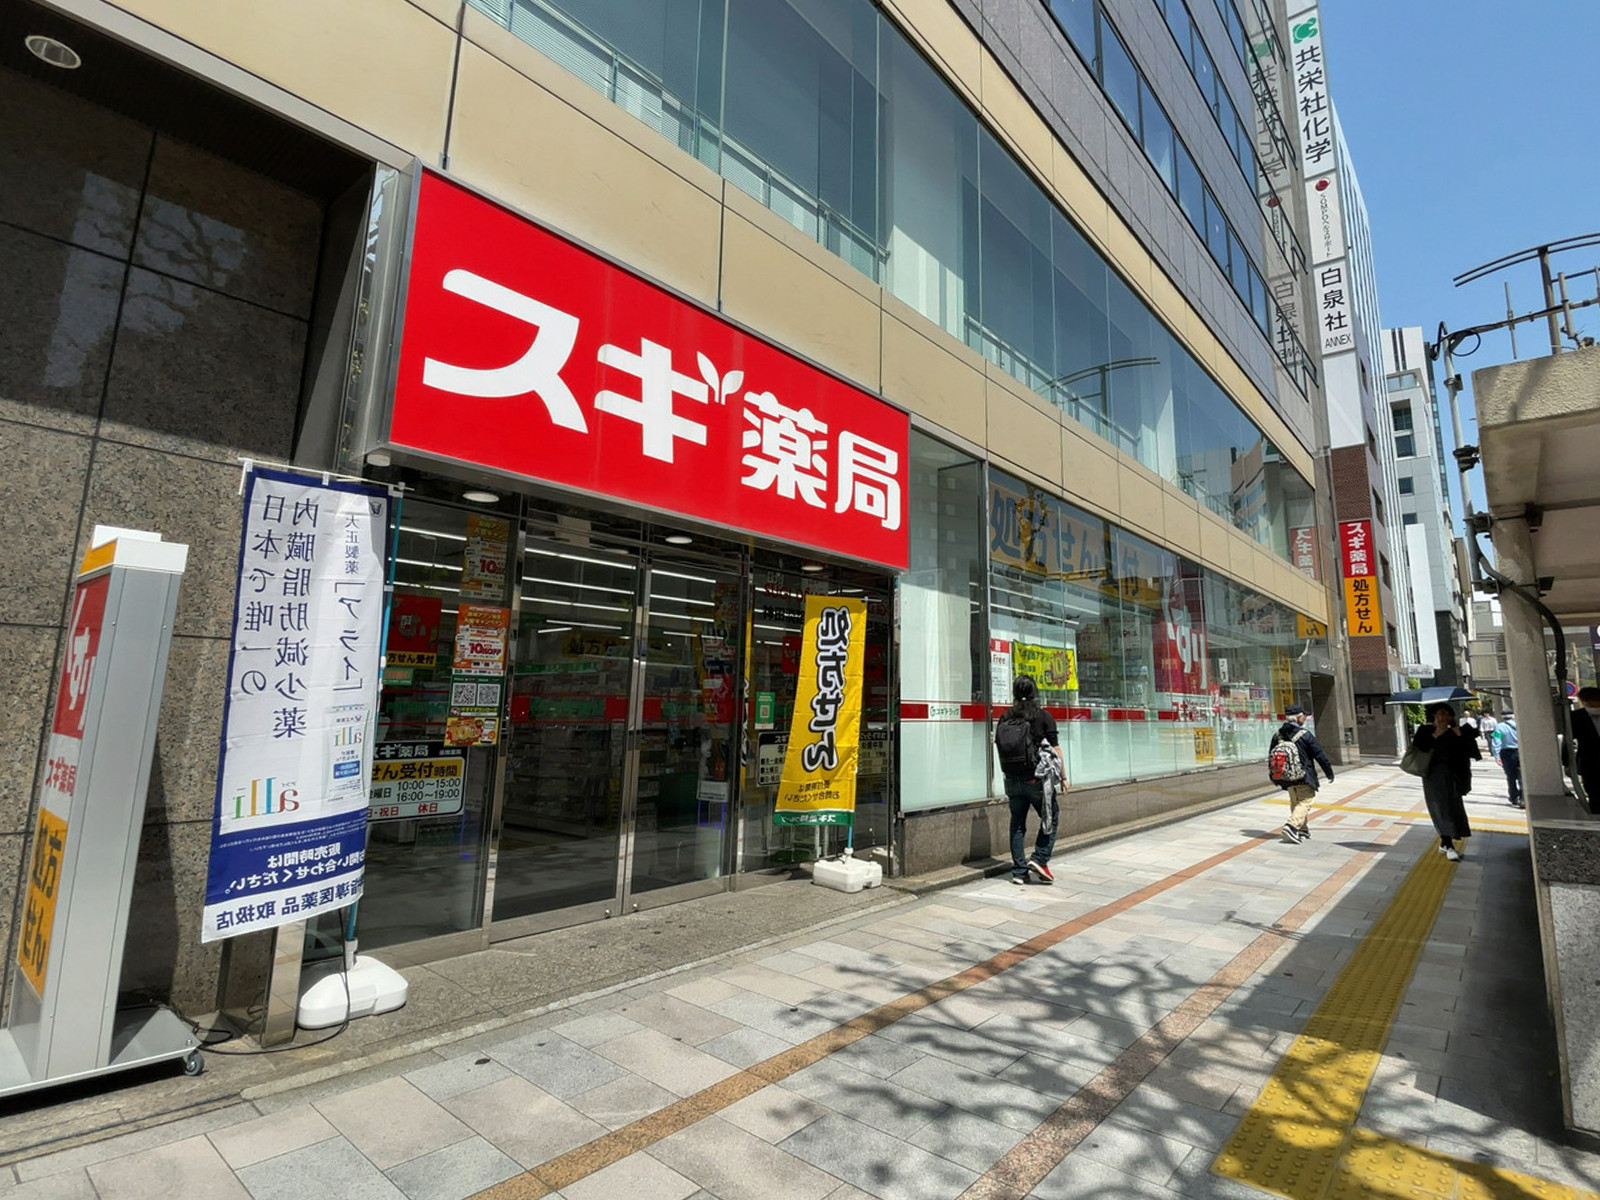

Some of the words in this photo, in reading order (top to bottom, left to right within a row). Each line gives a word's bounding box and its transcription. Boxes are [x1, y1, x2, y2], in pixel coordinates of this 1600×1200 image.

[1295, 45, 1332, 164] 共栄社化学
[1321, 267, 1348, 332] 白泉社
[1324, 333, 1352, 349] ANNEX
[422, 268, 902, 531] スギ薬局
[1347, 522, 1369, 576] スギ薬局
[1352, 578, 1373, 634] 処方せん
[45, 756, 77, 797] スギ薬局
[417, 802, 439, 814] 休日
